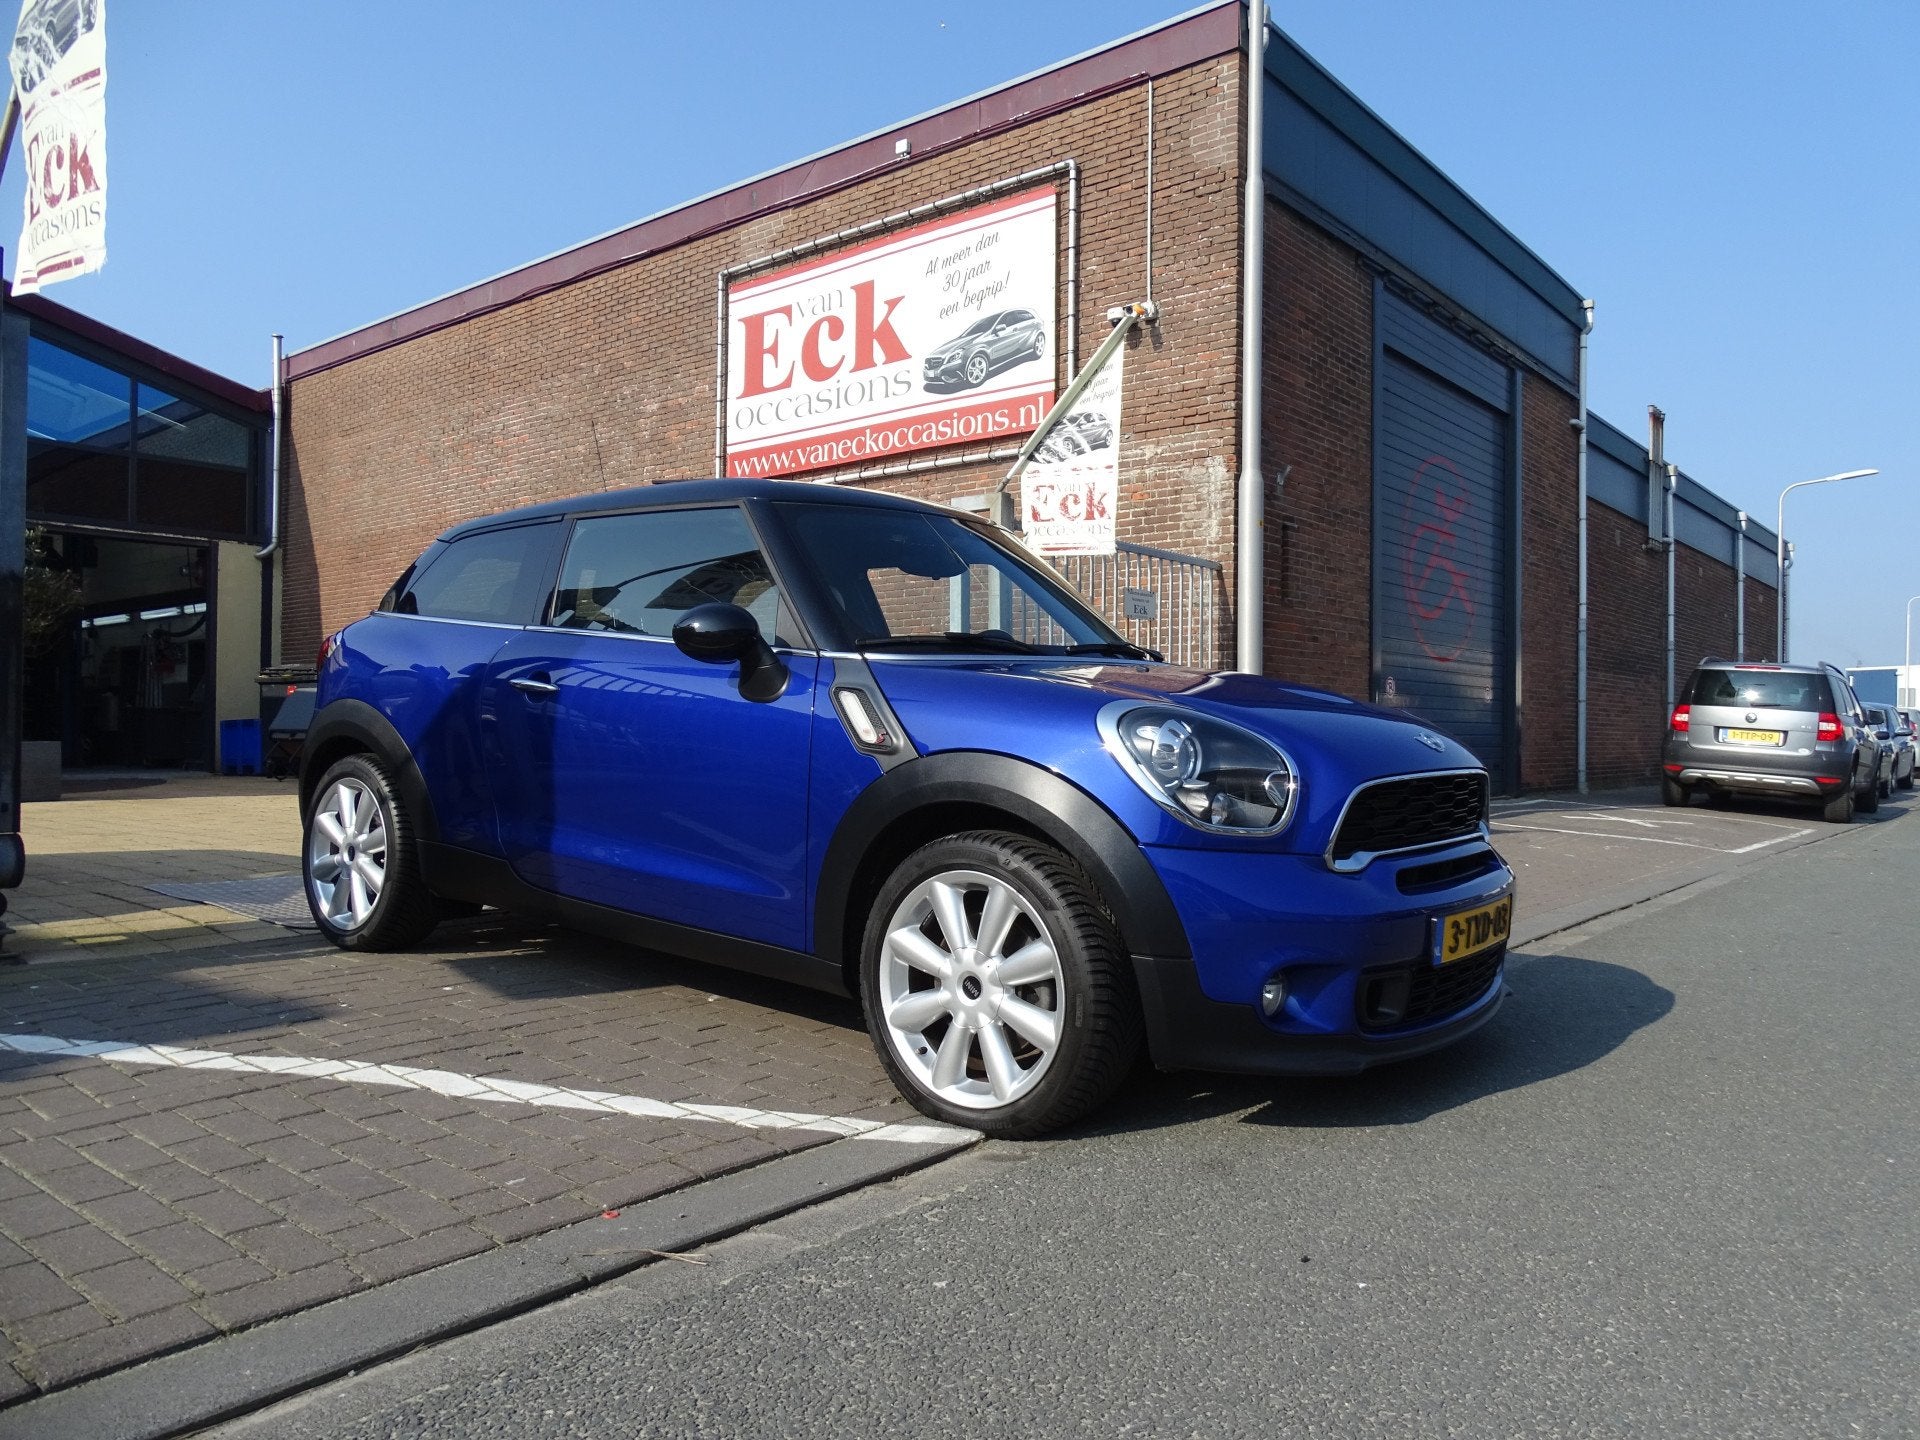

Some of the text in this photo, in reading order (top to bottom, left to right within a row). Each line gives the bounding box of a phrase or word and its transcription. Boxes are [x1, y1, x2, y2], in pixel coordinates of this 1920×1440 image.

[39, 120, 65, 147] van
[28, 130, 100, 225] Eck
[925, 231, 1001, 278] Al meer dan
[939, 270, 1011, 320] een begrip!
[942, 260, 992, 293] 30 jaar
[796, 288, 844, 320] van
[735, 279, 913, 400] Eck
[735, 367, 912, 430] occasions
[733, 396, 1046, 477] www.vaneckoccasions.nl
[1031, 482, 1112, 523] Eck
[1133, 604, 1148, 615] Eck
[1732, 731, 1774, 741] 1-TTP-09
[964, 979, 980, 998] MINI
